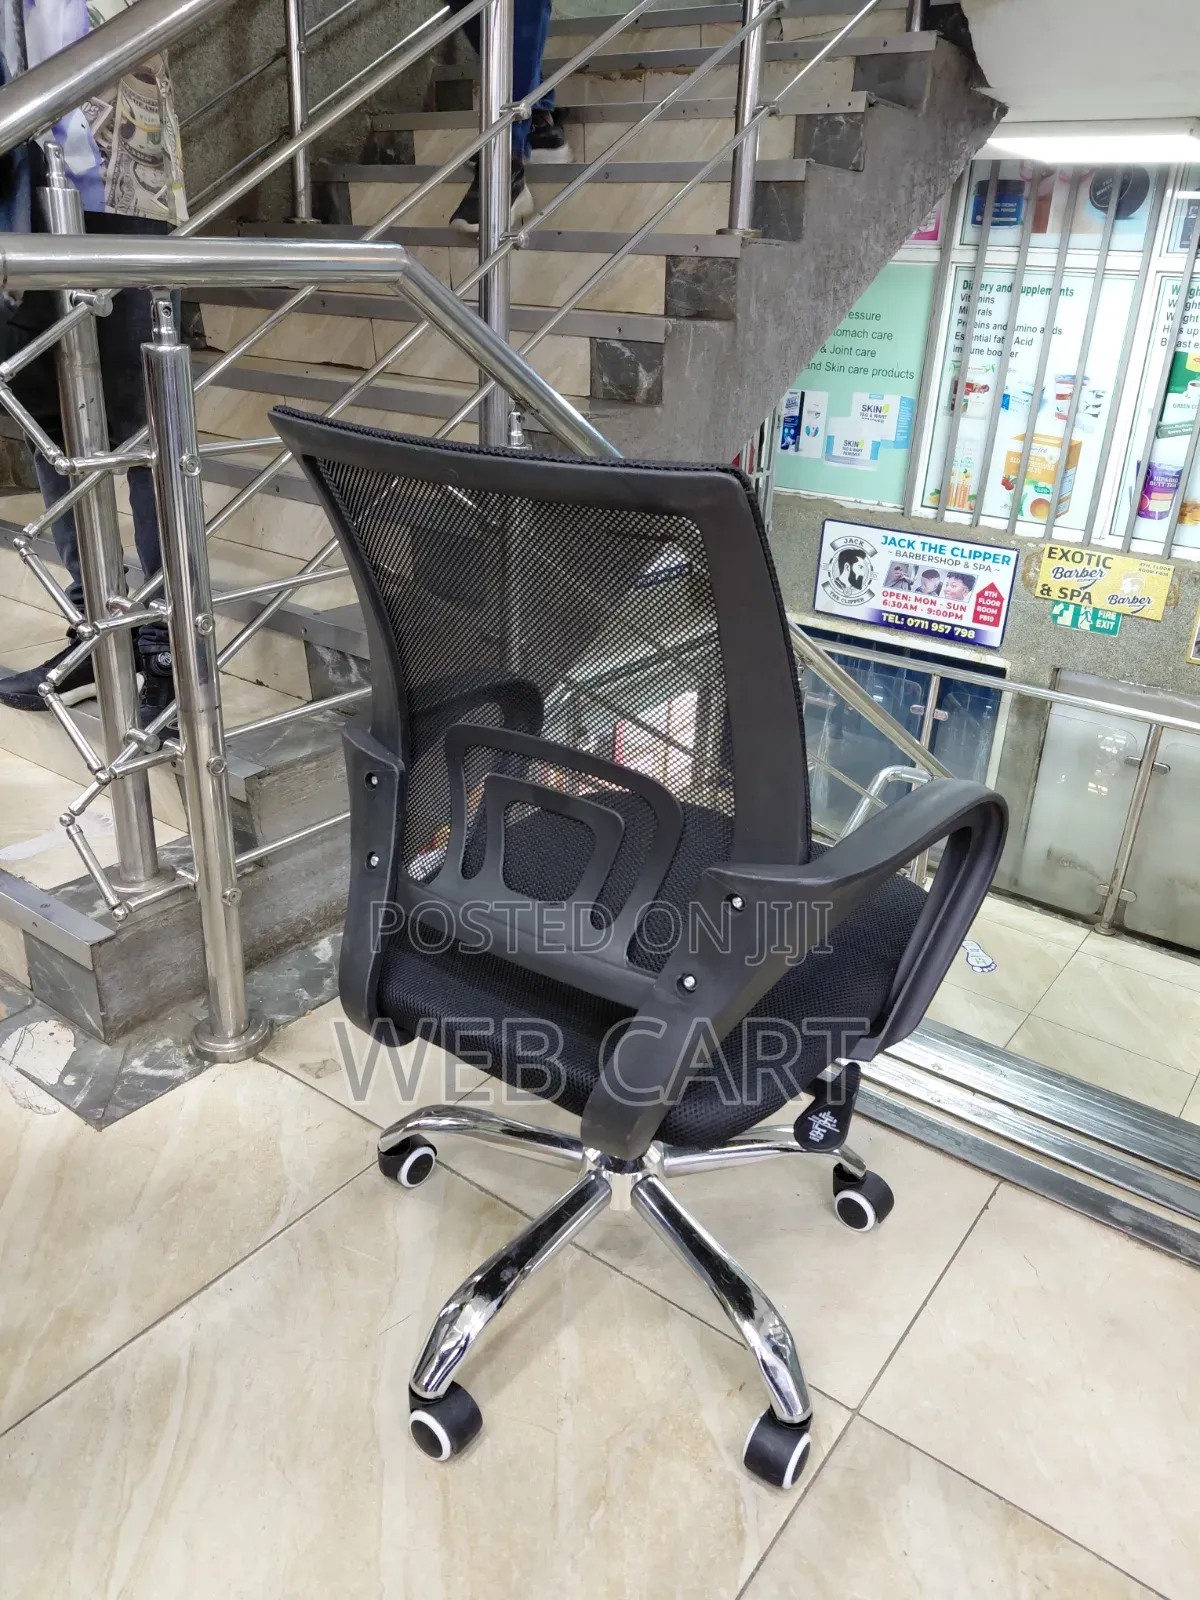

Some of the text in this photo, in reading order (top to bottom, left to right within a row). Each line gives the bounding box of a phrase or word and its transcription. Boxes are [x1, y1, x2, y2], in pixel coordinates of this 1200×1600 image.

[962, 280, 1074, 297] Diery and upplemnts
[1172, 284, 1200, 299] Wgh
[960, 294, 995, 304] Vitmins
[1168, 299, 1200, 311] Wght
[846, 311, 881, 321] essure
[959, 306, 992, 316] Mirals
[1166, 312, 1199, 324] Wght
[957, 319, 1062, 335] Preins and mino ads
[1163, 324, 1199, 337] His up
[834, 328, 893, 341] tomach care
[955, 332, 1033, 346] Esntial fat Acid
[1161, 337, 1191, 348] Bast
[820, 344, 876, 357] & Joint care
[953, 344, 1019, 358] Imune booer
[825, 362, 845, 373] Skin
[848, 366, 868, 375] care
[872, 368, 915, 380] products
[862, 404, 882, 413] SKIN
[844, 538, 864, 547] JACK
[881, 535, 1011, 565] JACK THE CLIPPER
[895, 550, 961, 567] BARBERSHOP
[973, 563, 992, 572] SPA
[1047, 546, 1114, 570] EXOTIC
[1052, 566, 1107, 580] Barber
[830, 591, 840, 601] THE
[1040, 583, 1093, 605] & SPA
[1108, 594, 1153, 605] Barber
[882, 591, 911, 602] OPEN:
[915, 596, 937, 606] MON
[947, 602, 967, 612] SUN
[978, 598, 1001, 607] FLOOR
[882, 600, 917, 611] 6:30AM
[927, 608, 963, 620] 9:00PM
[977, 606, 997, 615] ROOM
[1098, 610, 1117, 621] FIRE
[882, 613, 975, 639] TEL: 0711 957 798
[1095, 619, 1115, 630] EXIT
